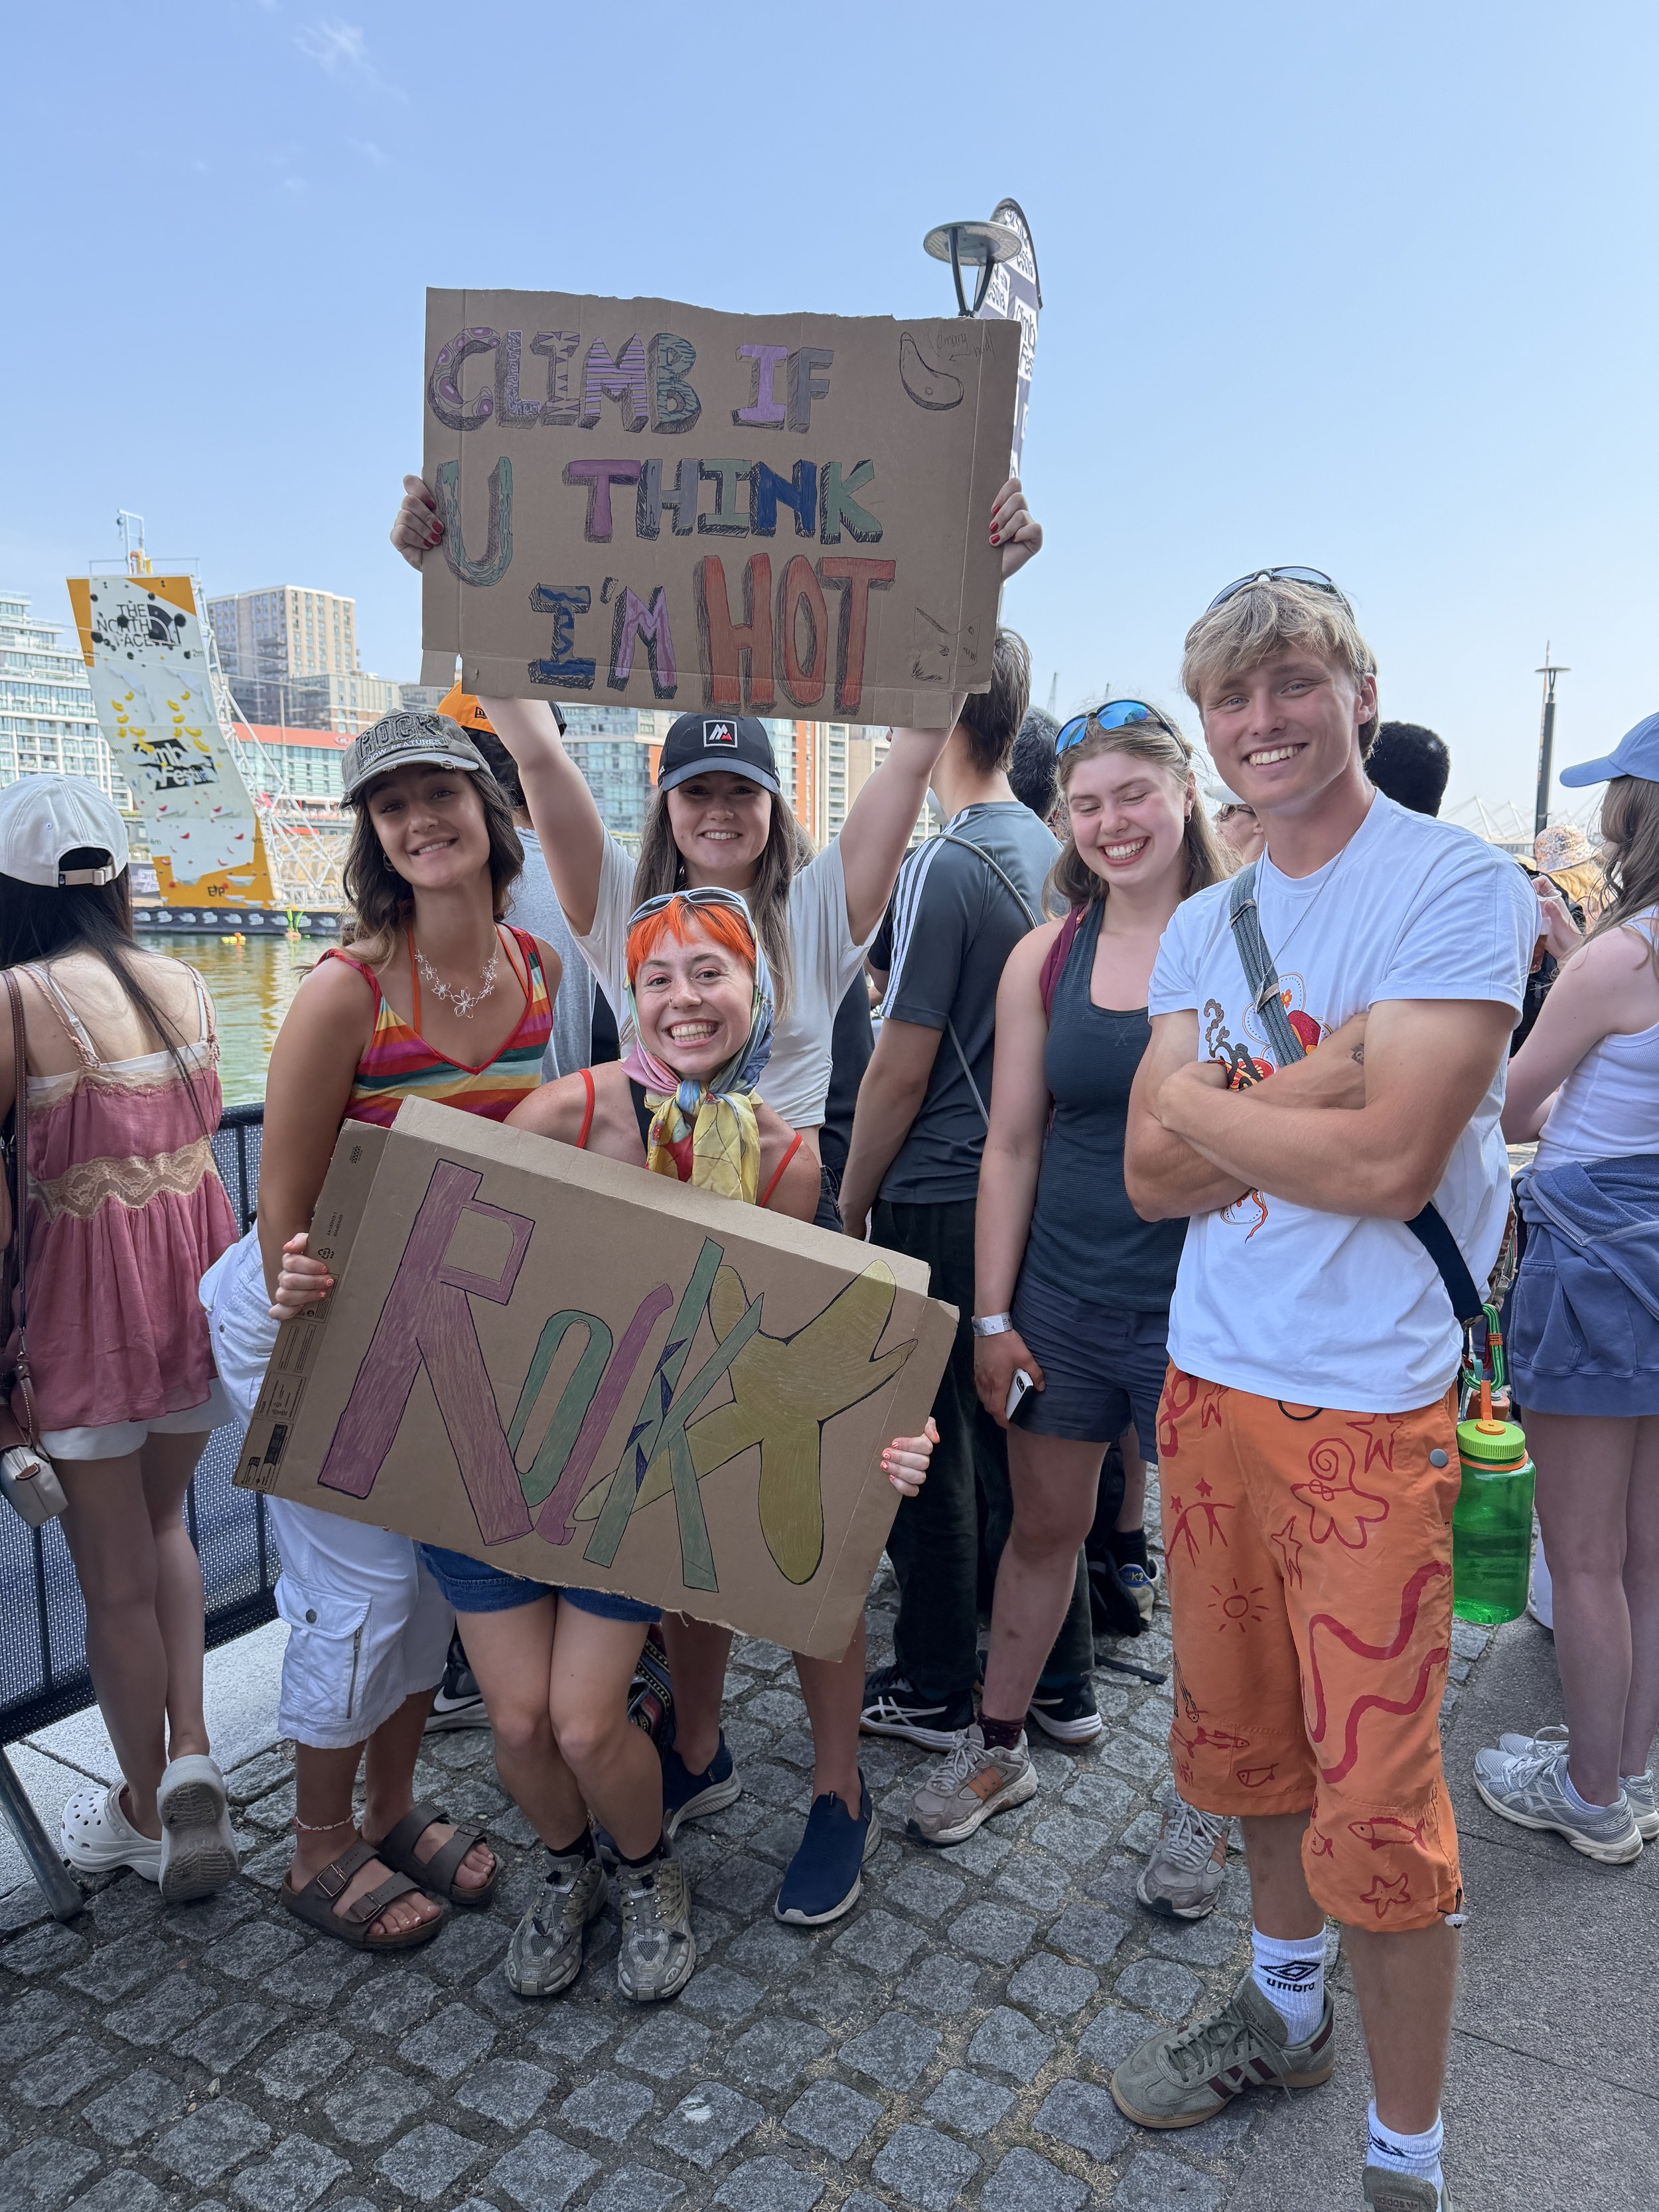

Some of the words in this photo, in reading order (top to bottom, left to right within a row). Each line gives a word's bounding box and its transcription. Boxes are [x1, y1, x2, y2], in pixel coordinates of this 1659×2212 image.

[427, 327, 702, 435] CLIMB
[731, 344, 834, 433] IF
[437, 457, 513, 587] U
[562, 458, 883, 545] THINK
[116, 604, 147, 617] THE
[115, 633, 153, 648] ACE
[528, 576, 678, 700] I'M
[693, 553, 897, 715] HOT
[357, 713, 443, 759] ROCK
[363, 748, 388, 766] SHOW
[390, 738, 441, 751] FEATURES
[1267, 1978, 1315, 1992] umbro
[1240, 1999, 1258, 2024] adidas
[1375, 2195, 1405, 2209] adidas
